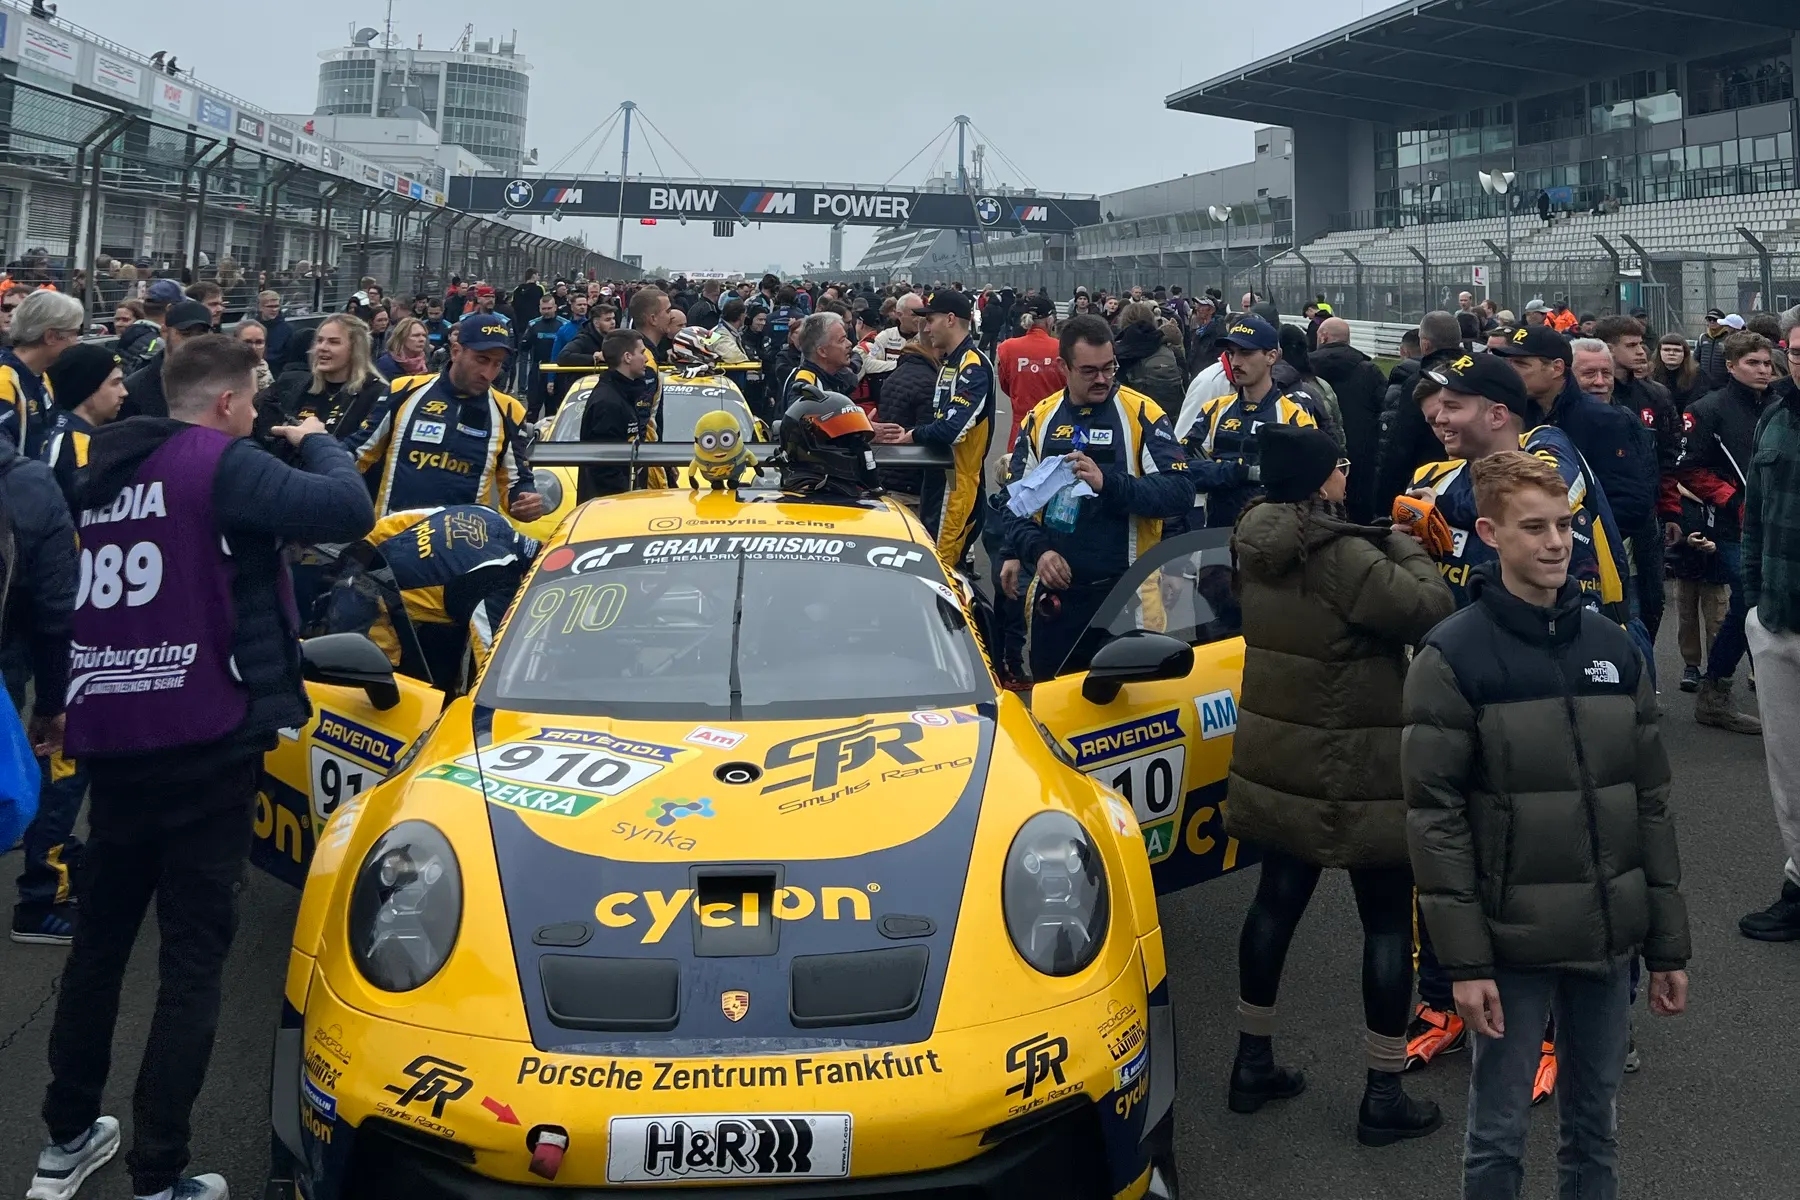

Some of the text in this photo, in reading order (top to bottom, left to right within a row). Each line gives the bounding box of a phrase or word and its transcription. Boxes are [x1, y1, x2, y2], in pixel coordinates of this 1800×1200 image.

[26, 27, 69, 52] PORSCHE
[649, 187, 719, 212] BMW
[813, 193, 909, 218] POWER
[481, 325, 508, 337] cyclon
[409, 450, 471, 475] cyclon
[686, 519, 835, 529] @smyrlis_racing
[643, 536, 722, 557] GRAN
[673, 554, 707, 562] REAL
[766, 553, 841, 563] SIMULATOR
[524, 583, 628, 639] 910
[72, 642, 198, 672] nürburgring
[1585, 667, 1607, 676] NORTH
[1592, 660, 1607, 668] THE
[153, 675, 185, 690] SERIE
[1591, 675, 1608, 683] FACE
[1202, 696, 1237, 733] AM
[320, 719, 392, 762] RAVENOL
[542, 730, 666, 758] RAVENOL
[695, 730, 735, 745] Am
[1080, 720, 1175, 758] RAVENOL
[490, 745, 631, 788] 910
[320, 758, 363, 814] 91
[477, 776, 578, 815] DEKRA
[777, 756, 973, 815] Smyrlis Racing
[1112, 757, 1173, 814] 10
[611, 820, 697, 851] synka
[517, 1049, 942, 1091] Porsche Zentrum Frankfurt
[1047, 1081, 1084, 1101] Racing
[414, 1112, 456, 1138] Racing
[646, 1120, 751, 1172] H&R
[841, 1118, 849, 1173] www.h-r.com
